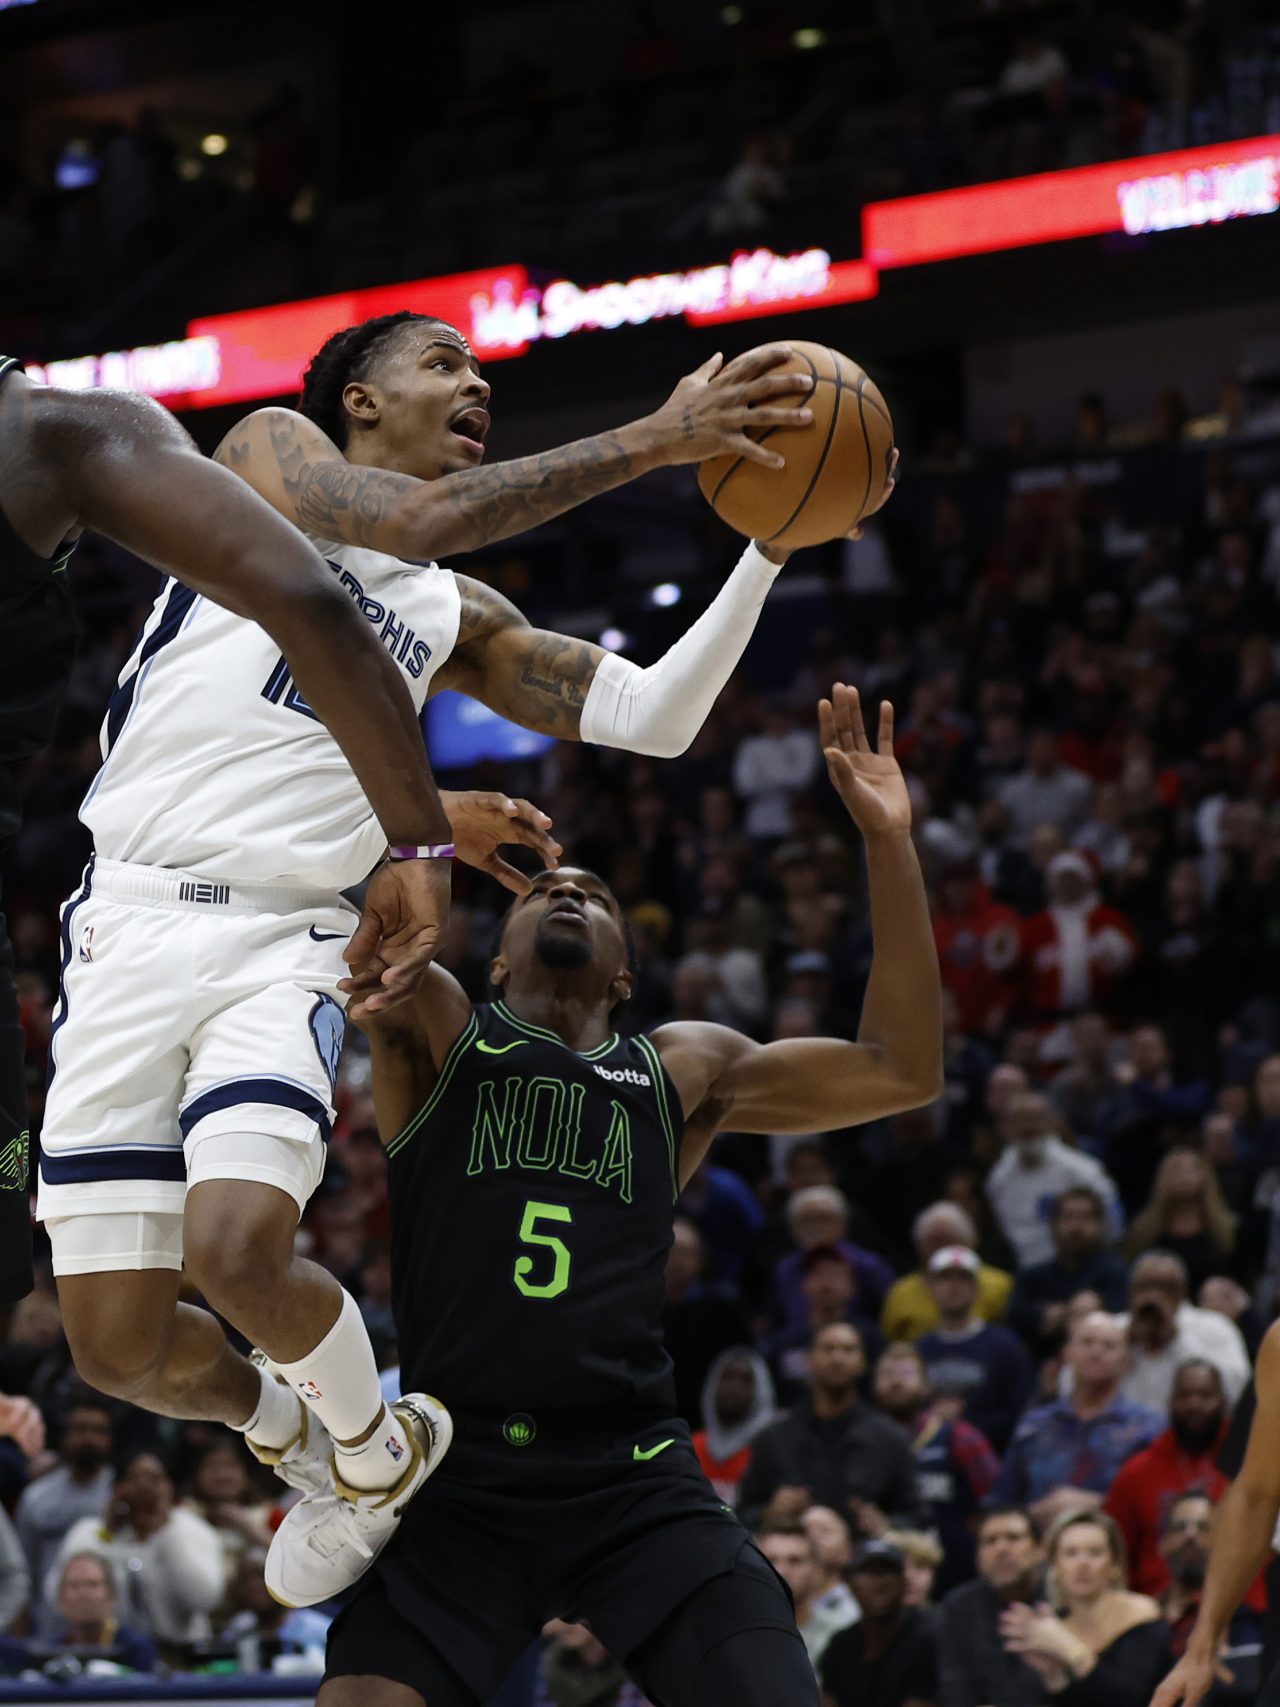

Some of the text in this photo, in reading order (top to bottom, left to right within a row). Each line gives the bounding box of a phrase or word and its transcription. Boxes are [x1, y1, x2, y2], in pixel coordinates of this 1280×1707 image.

[542, 248, 833, 339] SMOOTHIE KING
[325, 559, 433, 679] PHIS
[593, 1065, 651, 1086] ibotta
[466, 1076, 633, 1204] NOLA
[513, 1200, 572, 1299] 5
